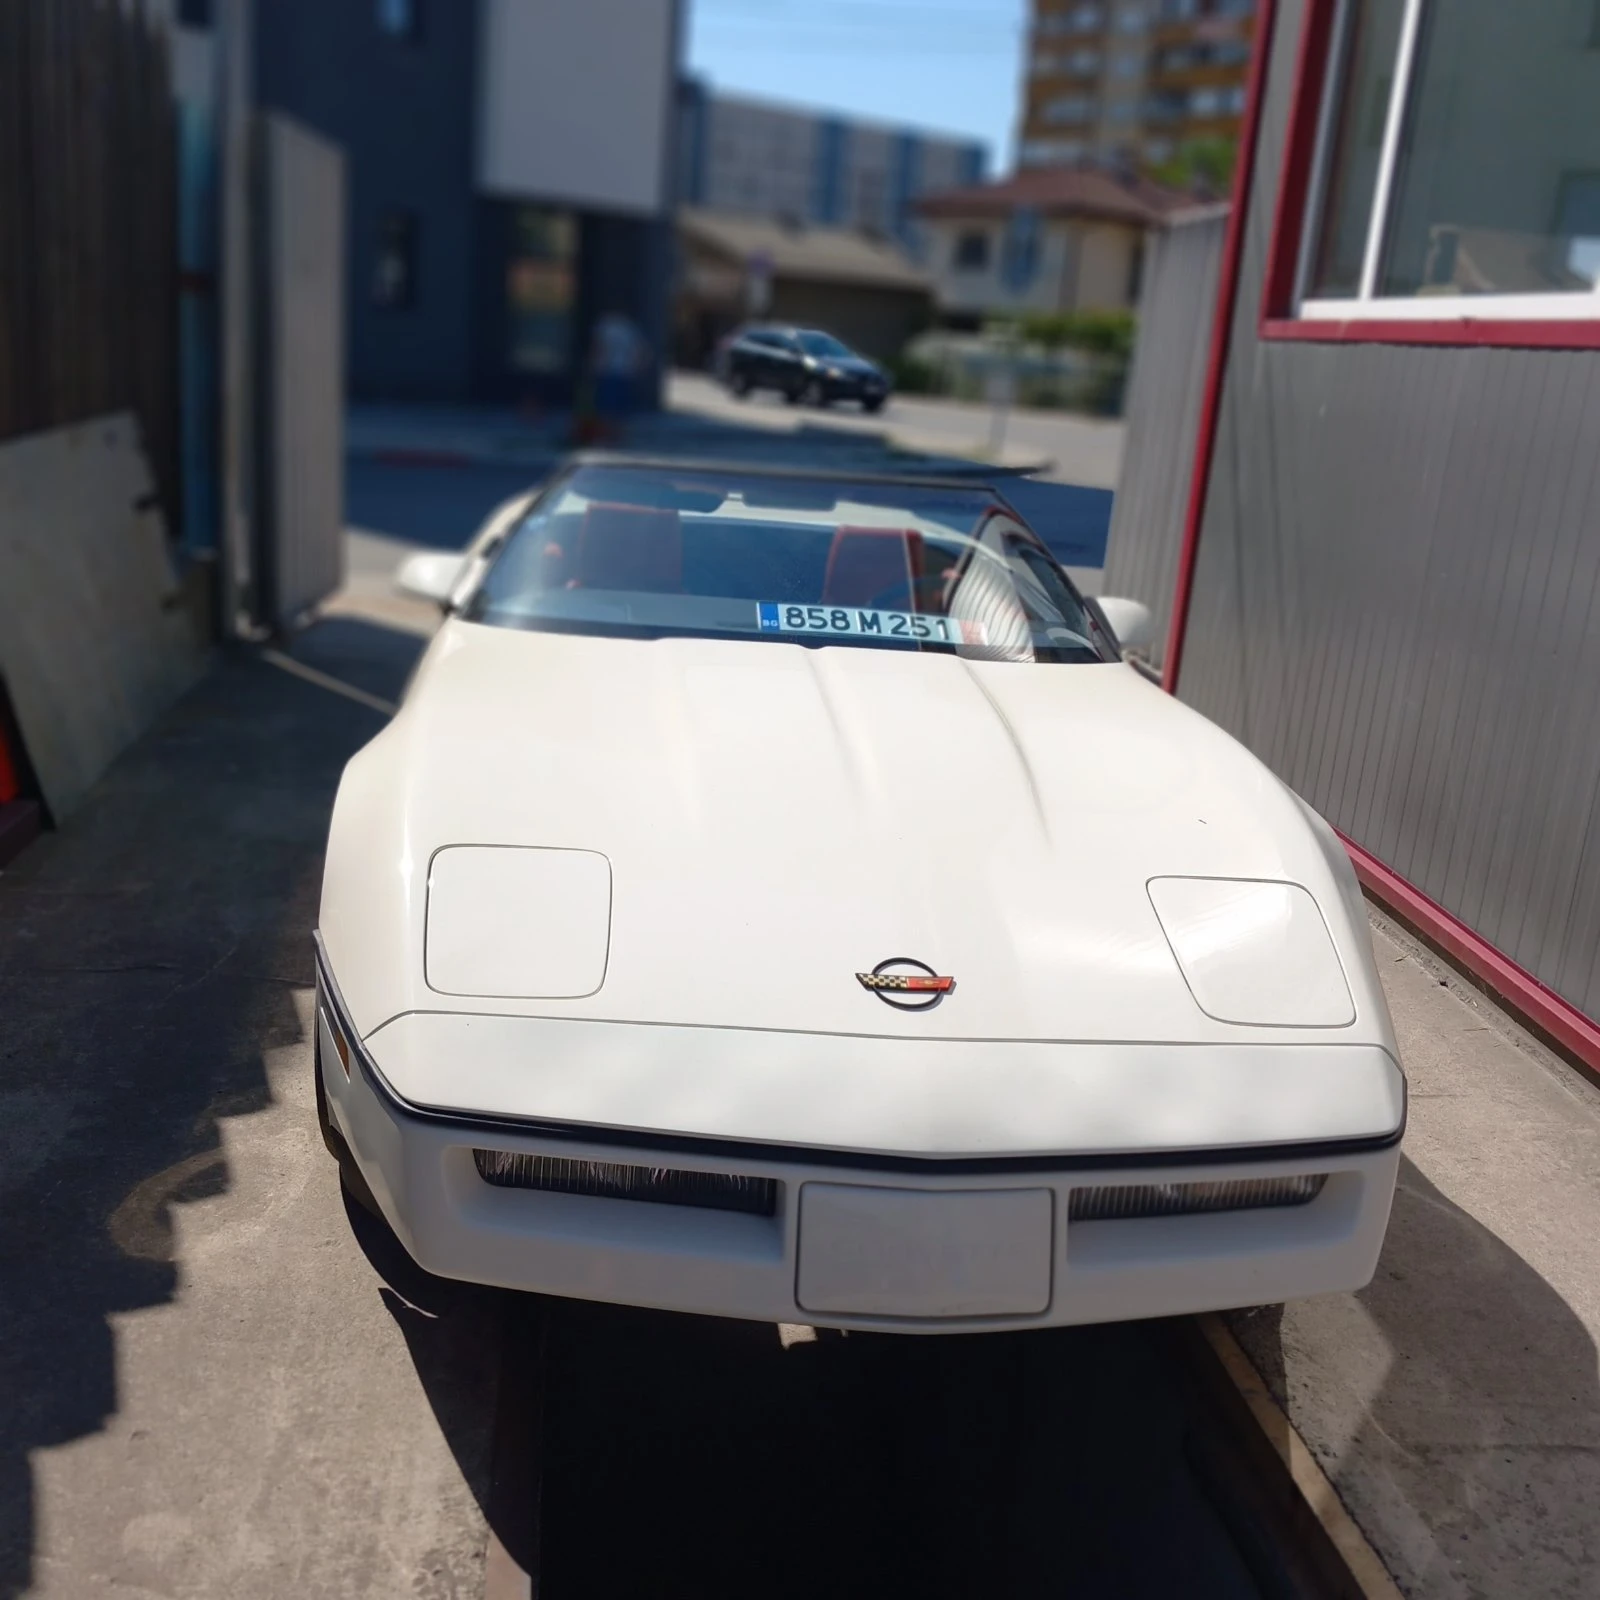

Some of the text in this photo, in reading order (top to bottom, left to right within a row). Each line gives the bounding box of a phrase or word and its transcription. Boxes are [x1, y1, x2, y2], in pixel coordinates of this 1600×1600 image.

[762, 619, 778, 627] BG
[785, 606, 949, 640] 858 M 251
